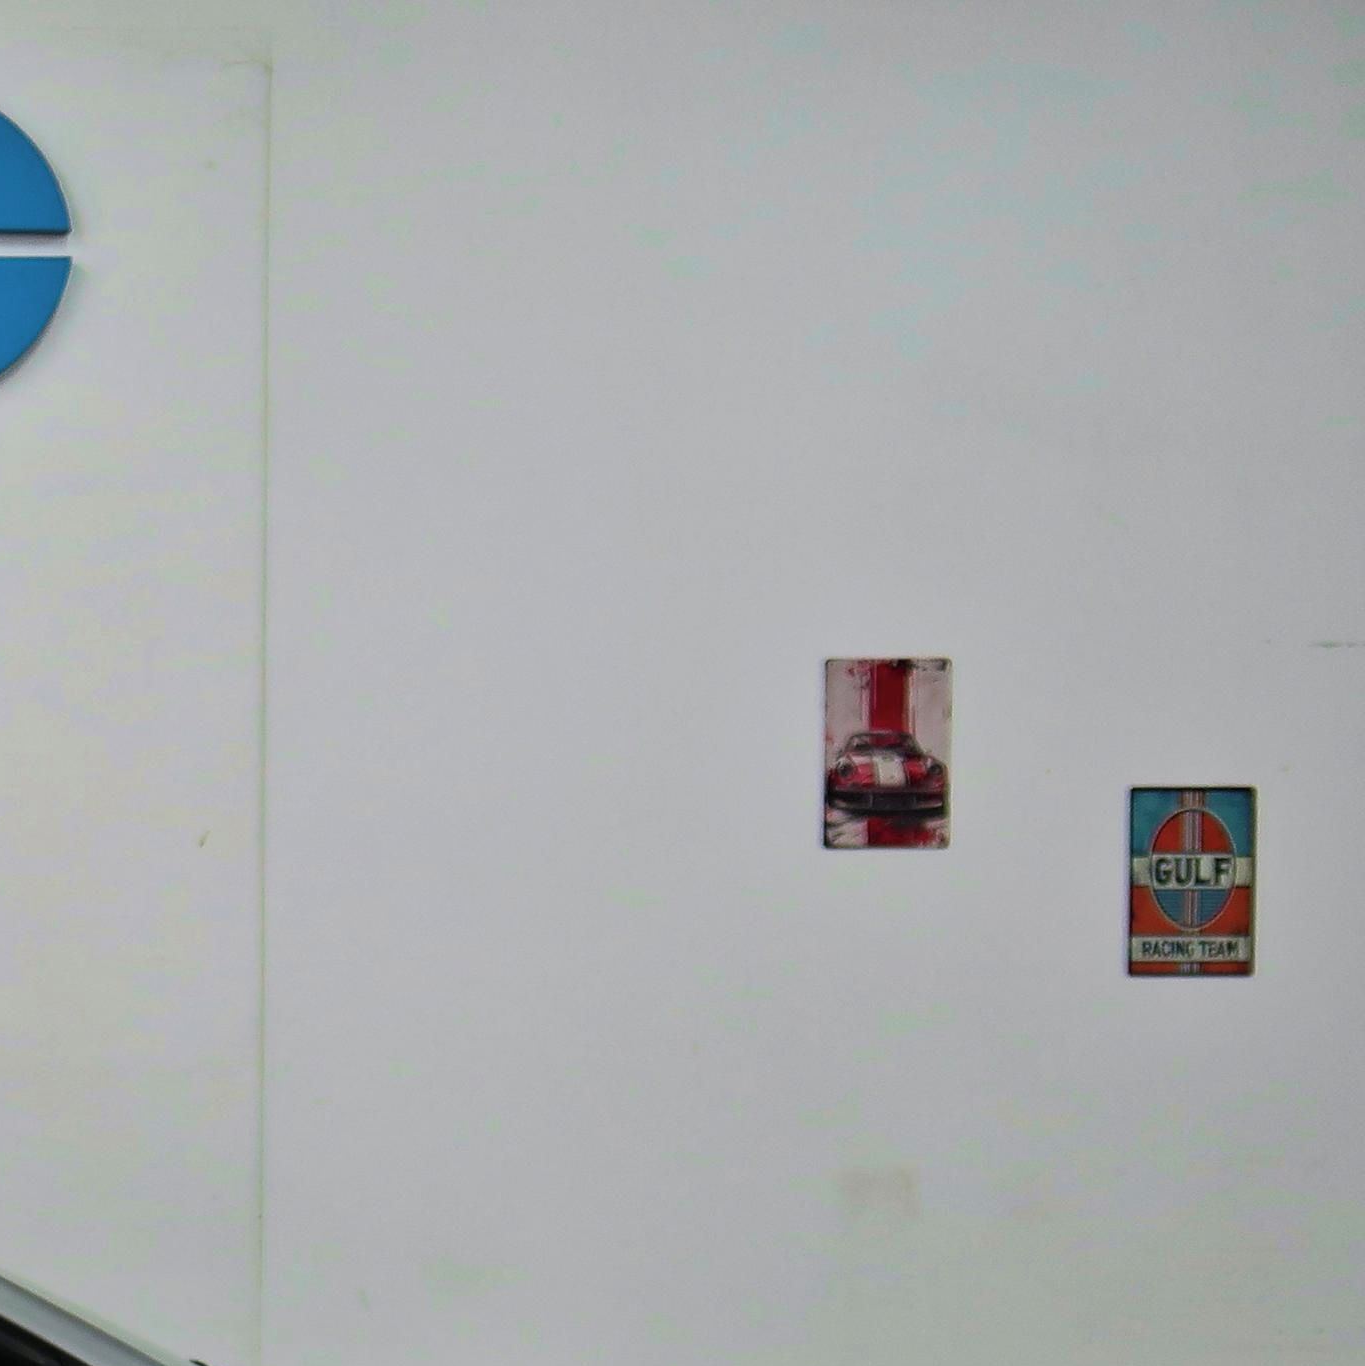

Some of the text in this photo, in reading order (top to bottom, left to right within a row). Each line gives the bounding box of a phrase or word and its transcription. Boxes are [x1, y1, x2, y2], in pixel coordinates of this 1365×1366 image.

[1155, 857, 1232, 886] GULF
[1141, 940, 1240, 958] RACING TEAM
